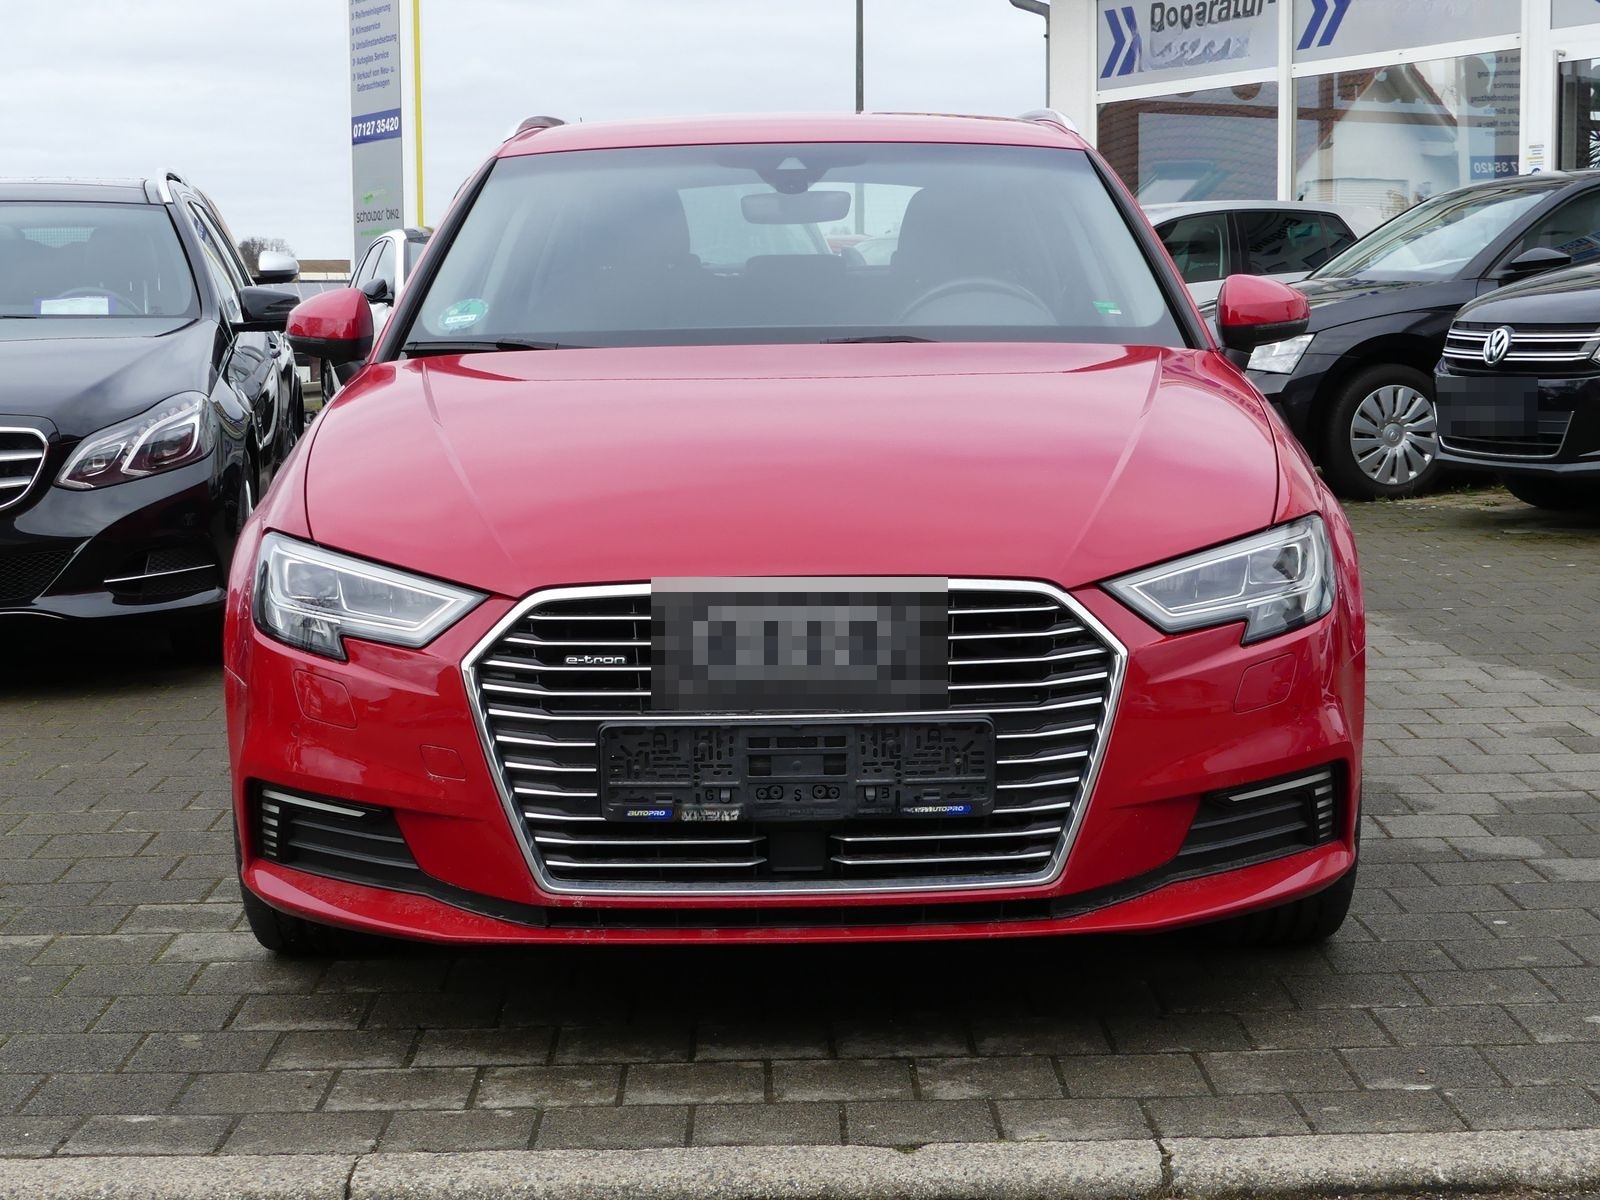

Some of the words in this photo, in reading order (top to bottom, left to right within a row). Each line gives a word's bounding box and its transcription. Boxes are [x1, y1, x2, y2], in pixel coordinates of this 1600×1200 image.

[355, 22, 381, 35] Klimaservice
[374, 50, 390, 62] Service
[353, 120, 376, 138] 07127
[376, 116, 399, 133] 35420
[565, 655, 626, 665] e-tron
